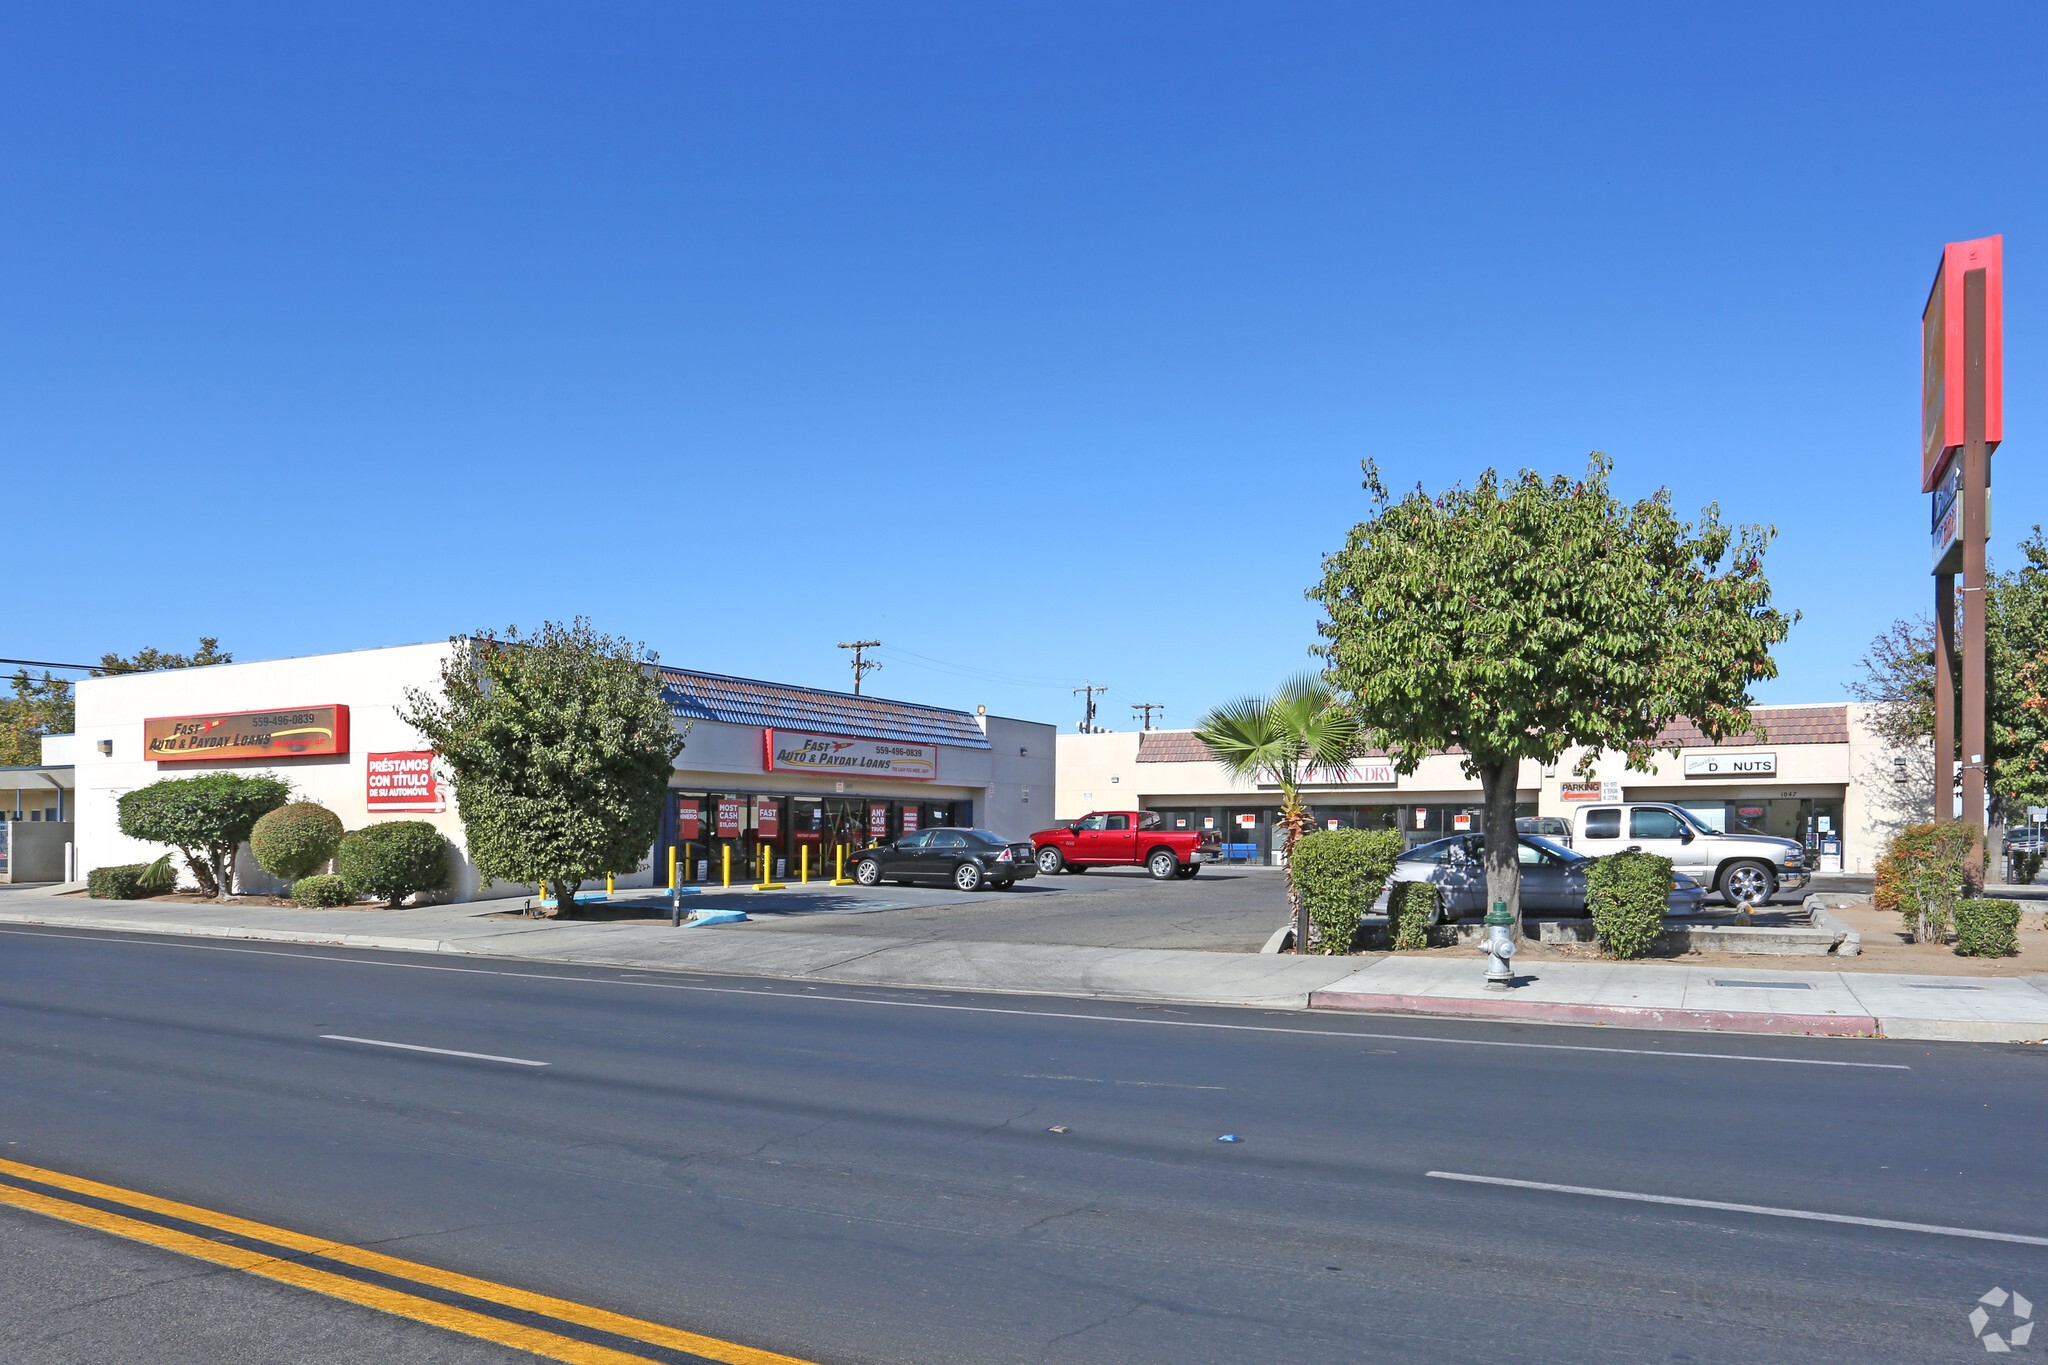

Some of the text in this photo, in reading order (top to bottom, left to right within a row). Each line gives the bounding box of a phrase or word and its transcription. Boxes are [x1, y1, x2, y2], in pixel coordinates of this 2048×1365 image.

[252, 713, 315, 728] 559-496-0839
[174, 722, 201, 736] FAST
[149, 737, 176, 751] AUTO
[179, 739, 186, 749] &
[188, 735, 230, 749] PAYDAY
[233, 733, 271, 747] LOANS
[803, 739, 830, 752] FAST
[876, 746, 922, 758] 559-496-0839
[369, 757, 429, 773] PRÉSTAMOS
[777, 749, 891, 769] AUTO & PAYDAY LOANS
[1733, 761, 1772, 771] NUTS
[369, 771, 429, 787] CON TÍTULO
[369, 785, 430, 797] DE SU AUTOMÓVIL
[1562, 783, 1599, 792] PARKING
[719, 804, 738, 812] MOST
[759, 808, 777, 817] FAST
[871, 808, 885, 817] ANY
[1738, 808, 1763, 816] OPEN
[719, 812, 738, 820] CASH
[871, 817, 885, 825] CAR
